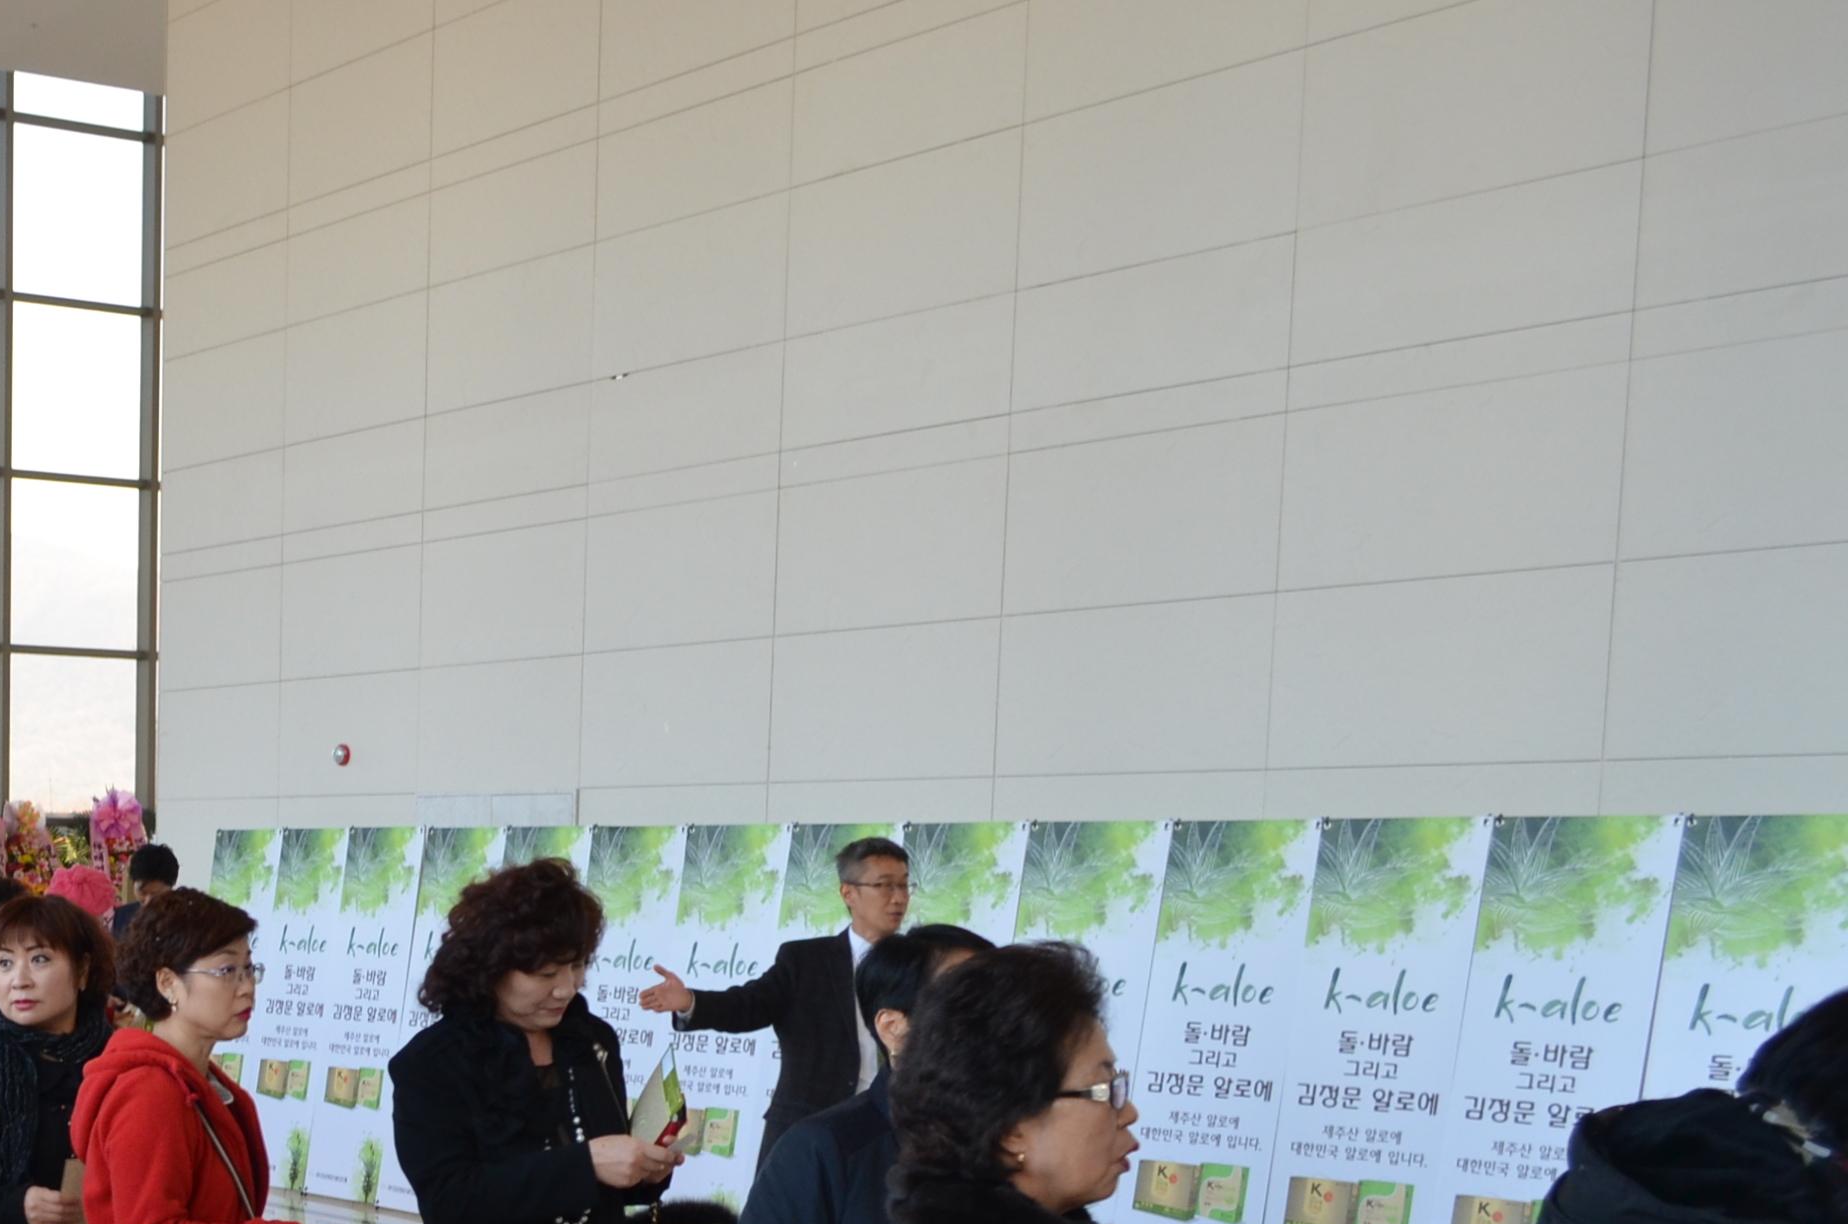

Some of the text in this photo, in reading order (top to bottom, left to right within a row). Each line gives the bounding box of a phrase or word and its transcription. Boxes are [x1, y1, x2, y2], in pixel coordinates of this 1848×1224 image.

[279, 924, 327, 954] k-aloe
[347, 927, 399, 958] k-aloe
[687, 941, 758, 978] k-aloe
[286, 984, 309, 996] 그리고
[355, 988, 380, 1001] 그리고
[1172, 961, 1274, 1007] k-aloe
[1324, 967, 1439, 1015] k-aloe
[266, 998, 324, 1018] 김정문 알로에
[1494, 973, 1622, 1025] k-aloe
[1689, 983, 1800, 1036] k-al
[333, 1004, 398, 1024] 김정문 알로에
[601, 1007, 630, 1021] 그리고
[669, 1032, 709, 1053] 김정문
[716, 1035, 756, 1055] 알로에
[1184, 1021, 1251, 1047] 돌·바람
[1338, 1030, 1414, 1058] 돌·바람
[1188, 1049, 1237, 1068] 그리고
[1510, 1041, 1594, 1070] 돌·바람
[1344, 1060, 1398, 1080] 그리고
[1147, 1071, 1273, 1102] 김정문 알로에
[1516, 1072, 1576, 1094] 그리고
[1297, 1083, 1440, 1116] 김정문 알로에
[1168, 1110, 1240, 1129] 제주산 알로에
[1464, 1096, 1595, 1129] 김정문 알로
[1140, 1127, 1183, 1143] 대한민국
[1188, 1131, 1221, 1147] 알로에
[1322, 1124, 1402, 1145] 제주산 알로에
[1291, 1141, 1339, 1160] 대한민국
[1345, 1147, 1381, 1164] 알로에
[1491, 1140, 1567, 1161] 제주산 알로
[1456, 1157, 1557, 1182] 대한민국 알로에
